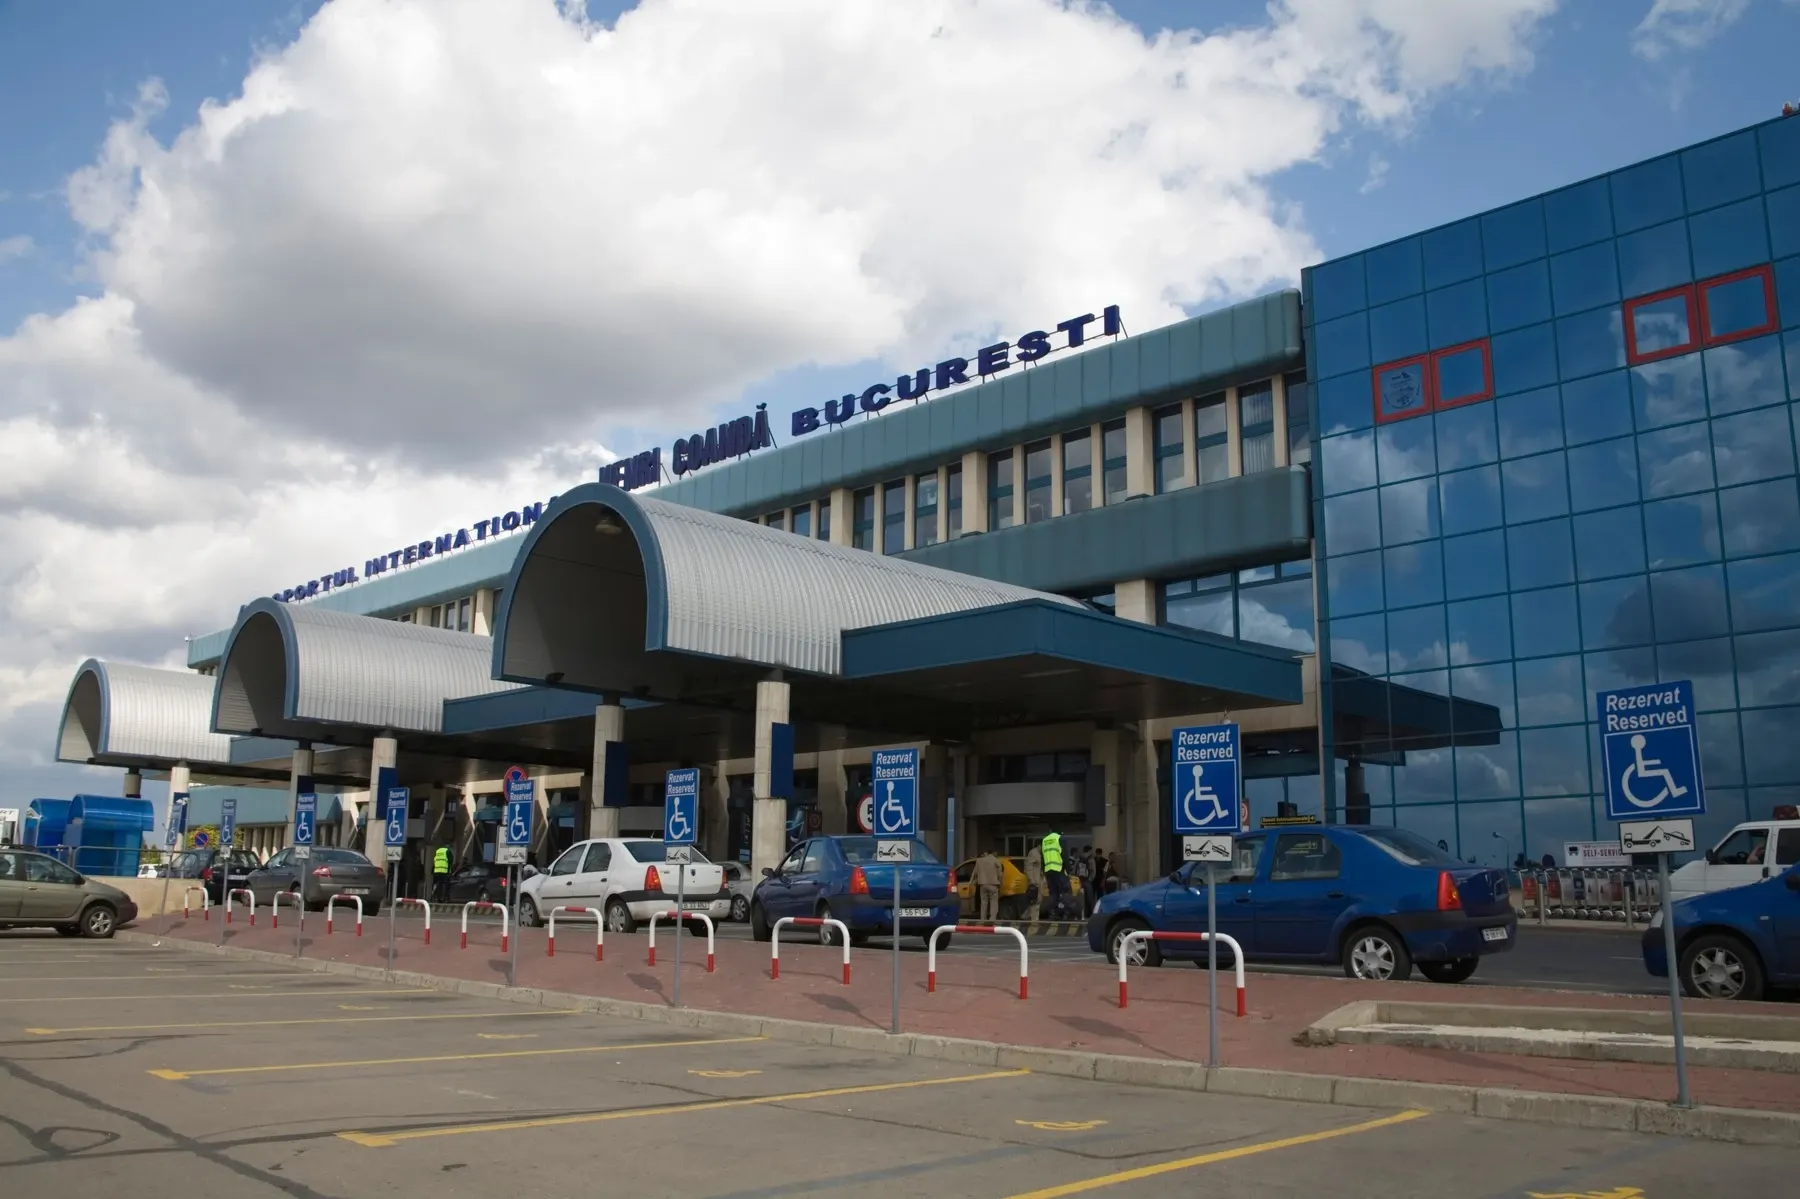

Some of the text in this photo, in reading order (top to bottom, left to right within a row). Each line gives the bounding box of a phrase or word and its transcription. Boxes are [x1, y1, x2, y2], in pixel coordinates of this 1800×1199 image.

[365, 496, 559, 577] INTERNATION
[792, 304, 1120, 436] BUCURESTI
[1606, 687, 1680, 712] Rezervat
[1607, 705, 1687, 732] Reserved
[1178, 728, 1231, 746] Rezervat
[876, 752, 913, 765] Rezervat
[1177, 743, 1233, 761] Reserved
[668, 772, 695, 783] Rezervat
[876, 765, 914, 778] Reserved
[667, 782, 695, 794] Reserved
[510, 792, 532, 801] Reserved
